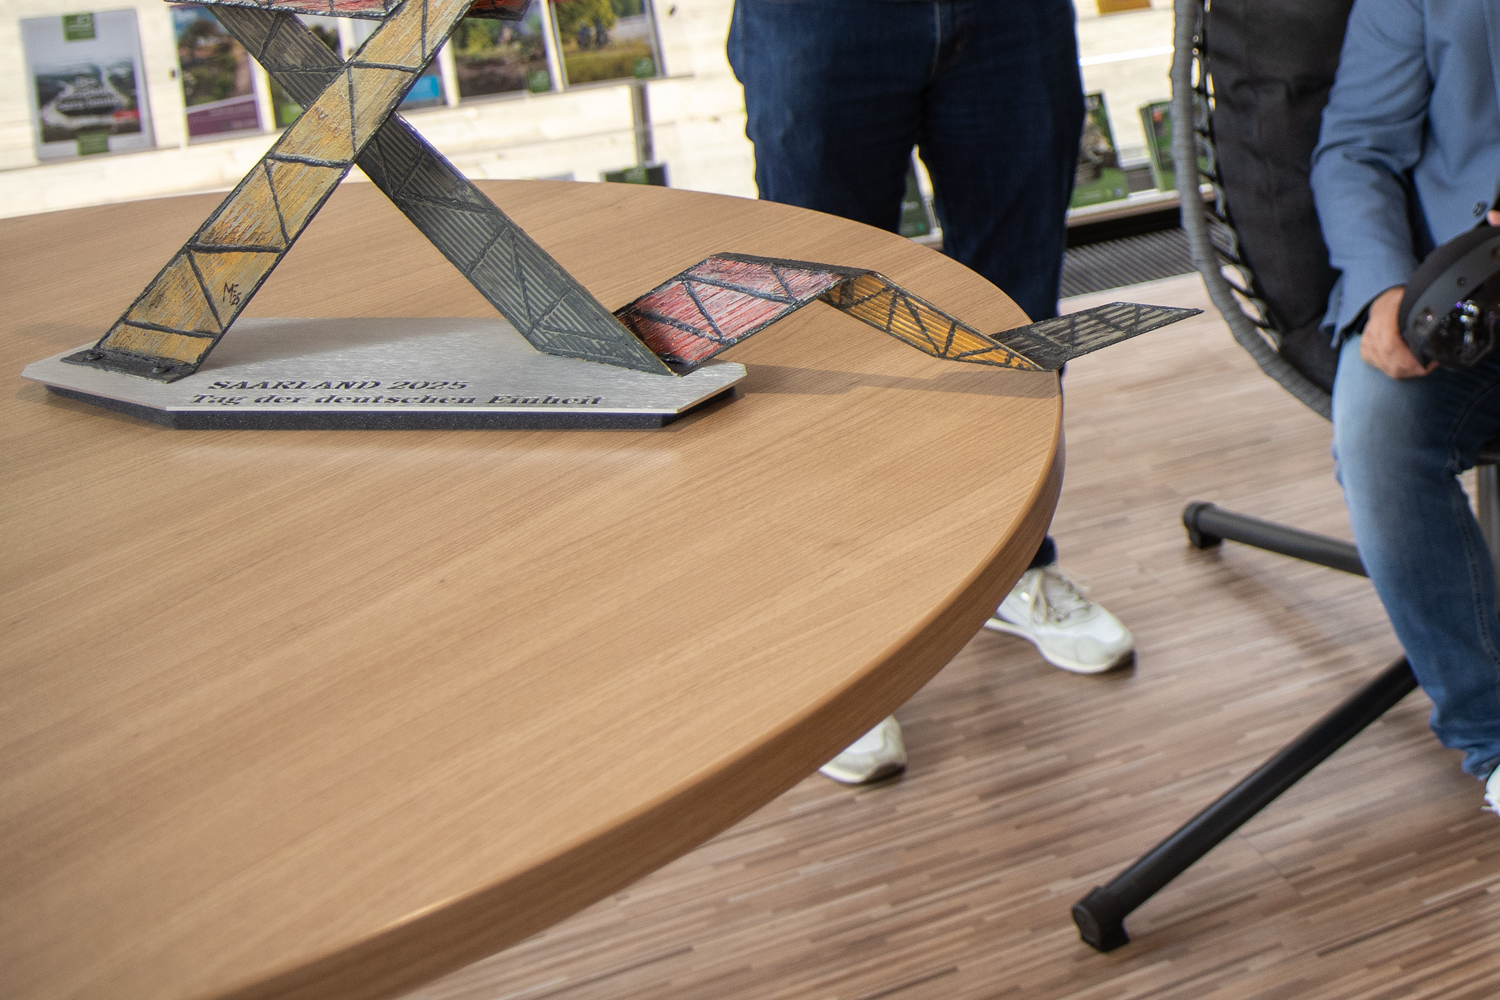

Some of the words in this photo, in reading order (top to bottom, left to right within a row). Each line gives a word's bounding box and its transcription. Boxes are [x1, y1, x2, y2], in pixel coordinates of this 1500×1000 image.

[207, 380, 382, 390] SAARLAND
[386, 380, 470, 390] 2025
[189, 393, 249, 406] Tag
[253, 394, 308, 404] der
[314, 394, 476, 405] deutschen
[485, 394, 606, 405] Einheit
